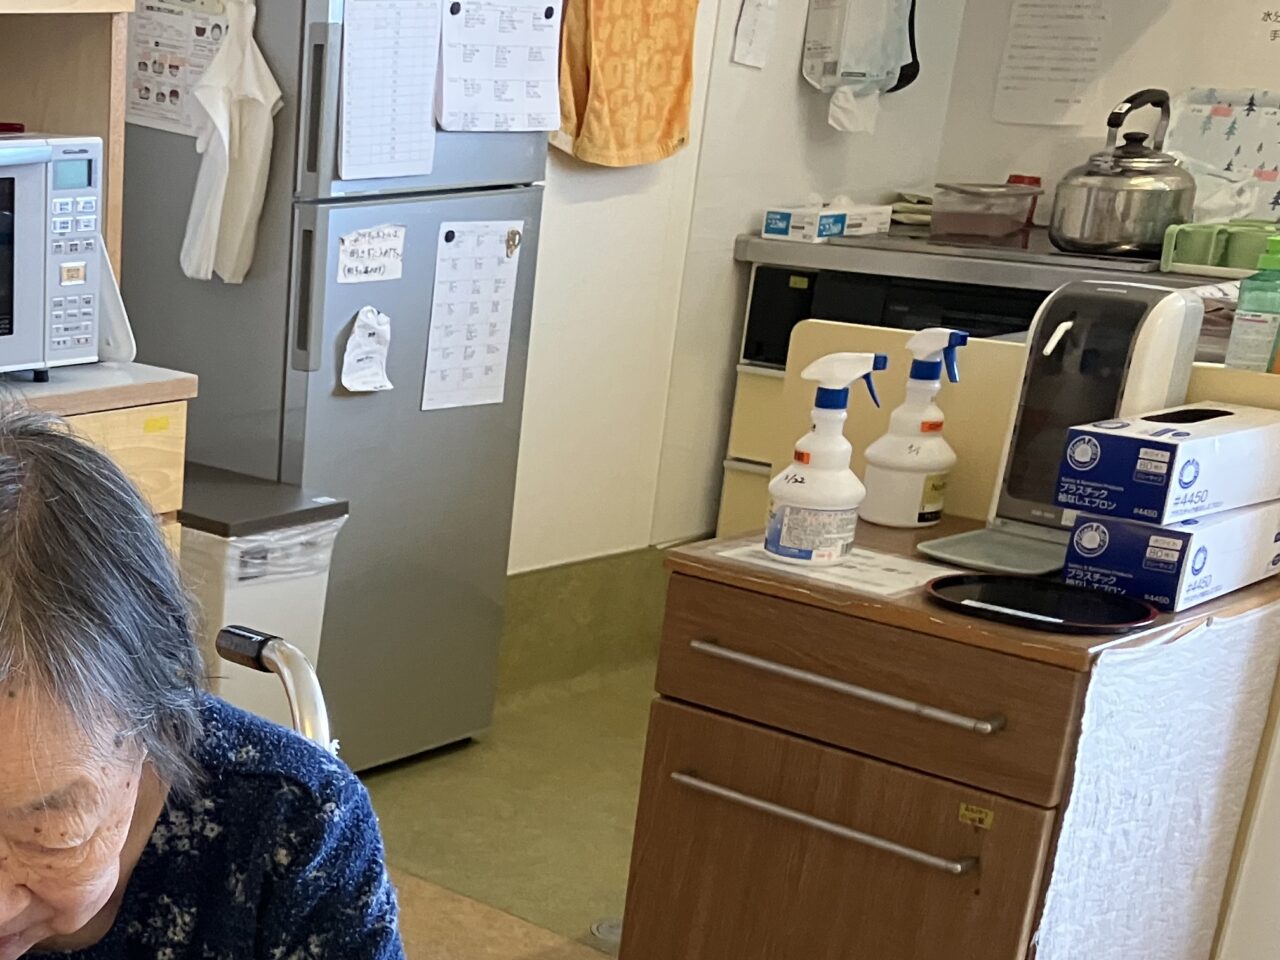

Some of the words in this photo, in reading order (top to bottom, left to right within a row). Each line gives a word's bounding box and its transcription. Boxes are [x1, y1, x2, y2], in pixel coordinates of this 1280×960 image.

[1060, 482, 1108, 499] プラスチック
[1173, 489, 1209, 506] #4450
